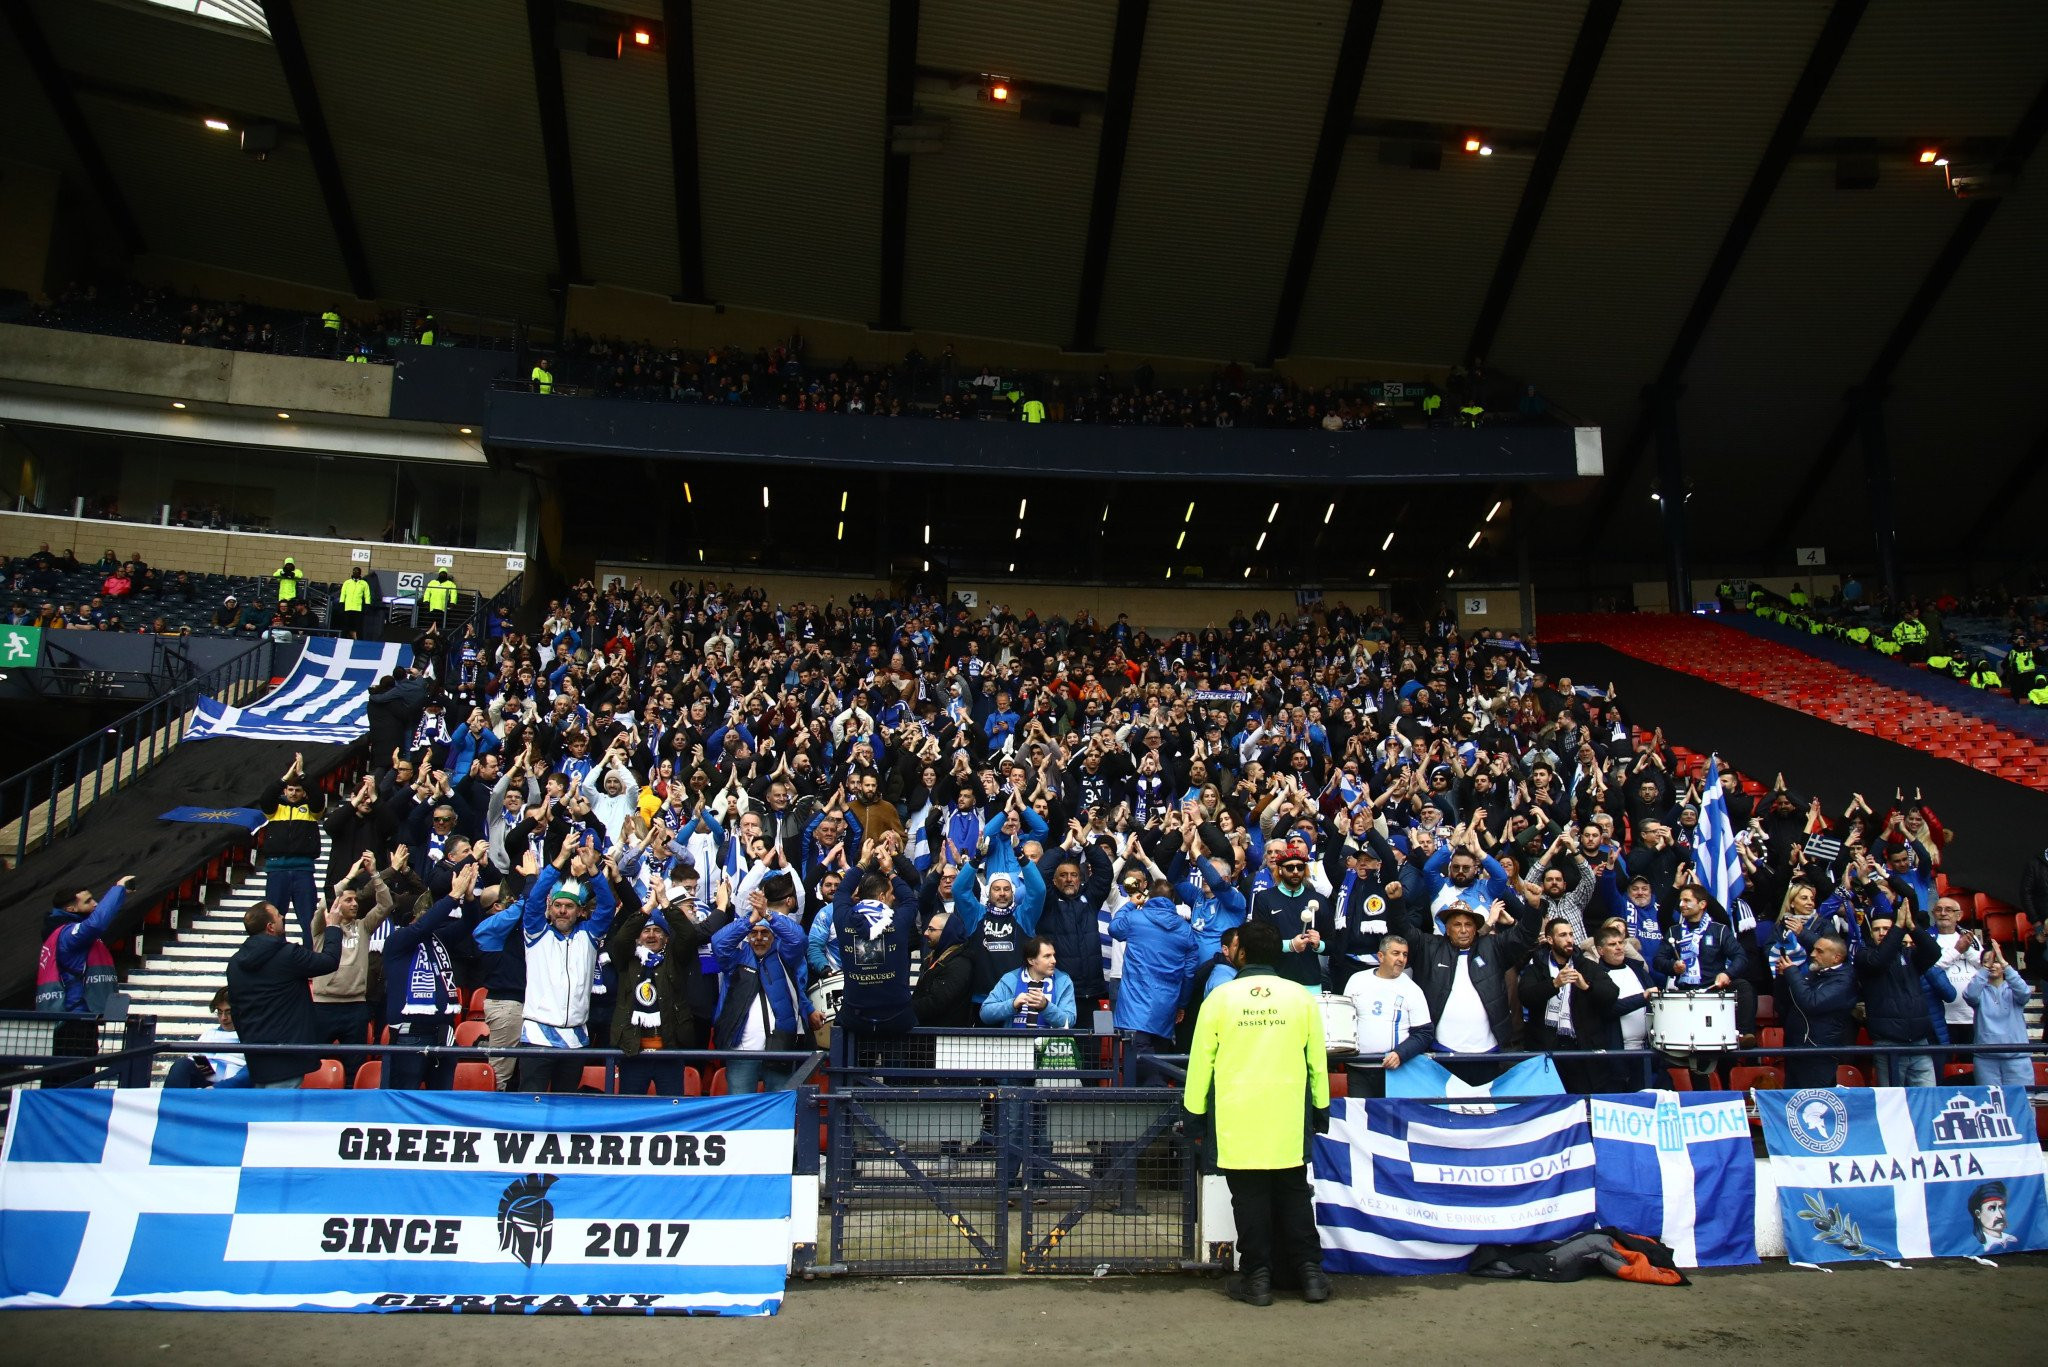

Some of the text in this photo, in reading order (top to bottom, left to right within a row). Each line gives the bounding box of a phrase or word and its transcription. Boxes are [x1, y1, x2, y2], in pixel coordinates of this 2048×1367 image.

[1806, 550, 1816, 562] 4
[399, 575, 423, 588] 56
[961, 593, 972, 605] 2
[1470, 600, 1480, 612] 3
[1243, 1008, 1266, 1016] Here
[1371, 1000, 1383, 1016] 3
[1237, 1019, 1286, 1027] assist you
[1044, 1042, 1074, 1057] ASDA
[1593, 1106, 1748, 1138] ΗΛΙΟΥ ΠΟΛΗ
[337, 1126, 726, 1167] GREEK WARRIORS
[1438, 1150, 1572, 1183] ΗΛΙΟΥΠΟΛΗ
[1828, 1152, 1985, 1184] ΚΑΛΑΜΑΤΑ
[320, 1217, 690, 1259] SINCE 2017
[371, 1293, 665, 1307] GERMANY
